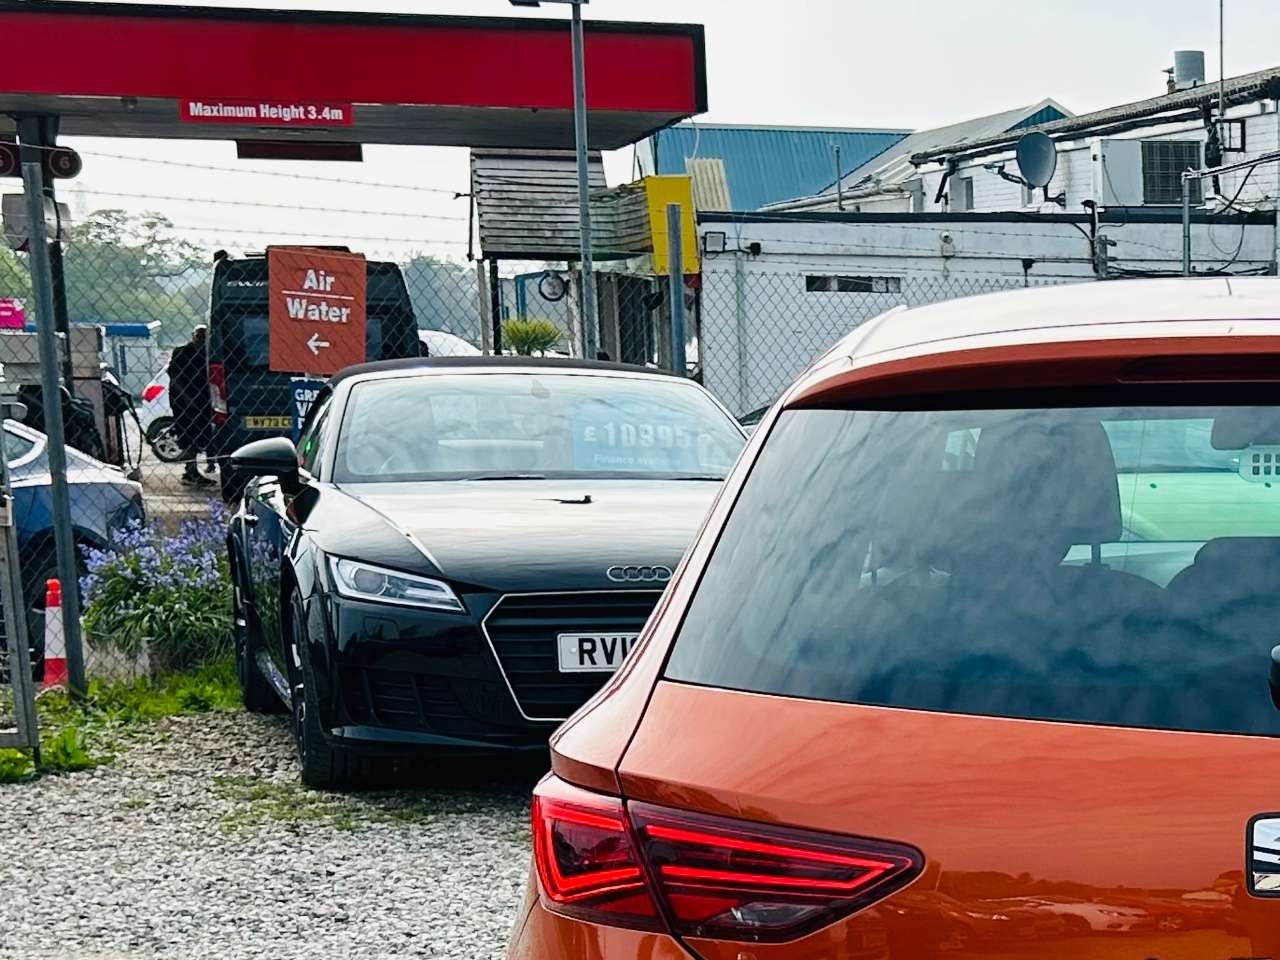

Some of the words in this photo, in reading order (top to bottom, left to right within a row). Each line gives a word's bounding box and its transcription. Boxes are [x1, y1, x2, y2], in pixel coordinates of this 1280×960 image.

[189, 102, 257, 118] Maximum
[260, 103, 305, 122] Height
[307, 105, 344, 121] 3.4m
[303, 269, 336, 292] Air
[286, 297, 351, 323] Water
